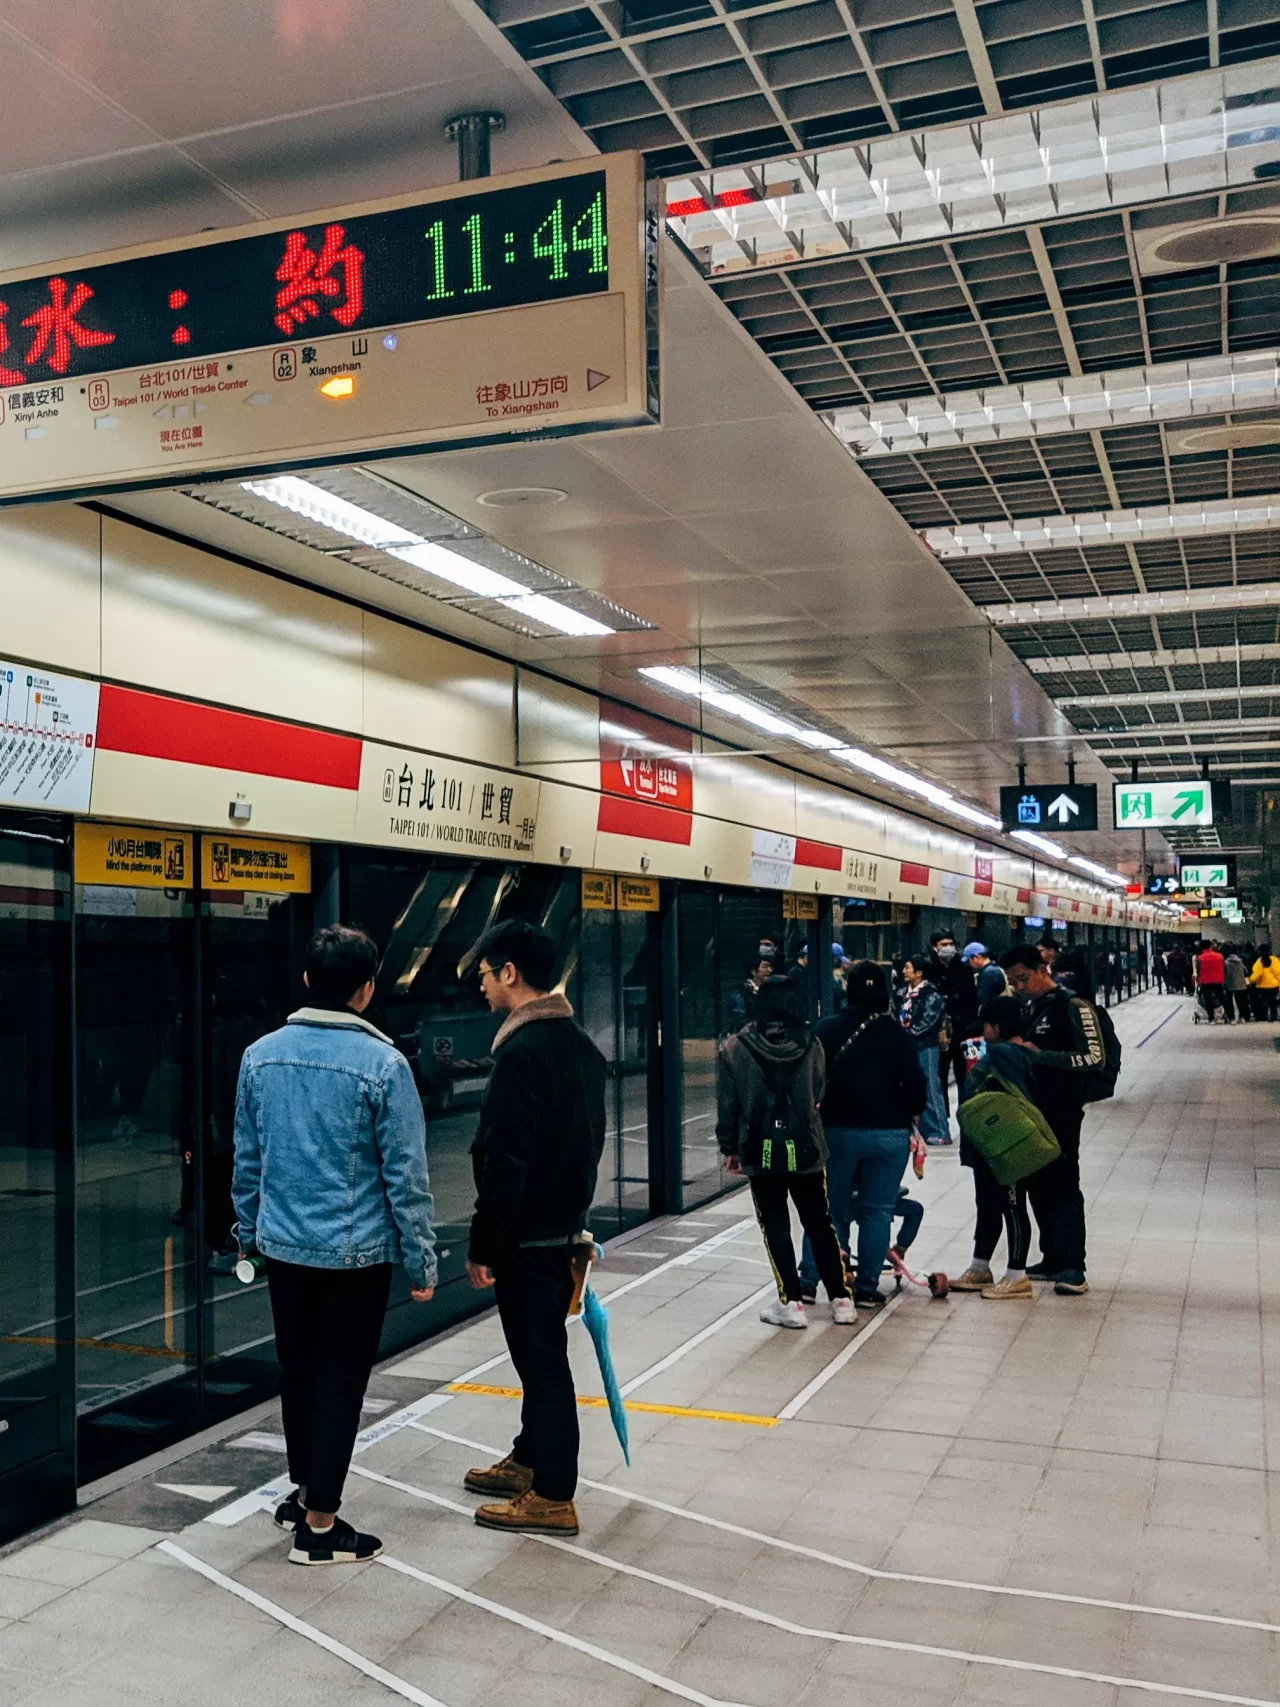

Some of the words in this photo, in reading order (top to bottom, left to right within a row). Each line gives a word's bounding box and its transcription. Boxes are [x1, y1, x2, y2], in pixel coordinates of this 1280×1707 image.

[424, 191, 608, 300] 11:44
[275, 224, 365, 334] 約
[280, 353, 289, 364] R
[139, 361, 219, 389] 台北101/世貿
[277, 365, 293, 377] 02
[308, 362, 361, 377] Xiangshan
[7, 386, 65, 410] 信義安和
[94, 384, 103, 395] R
[112, 395, 138, 408] Taipei
[140, 392, 154, 403] 101
[163, 386, 189, 400] World
[191, 383, 216, 396] Trade
[217, 379, 249, 393] Center
[476, 375, 568, 404] 往象山方向
[92, 395, 106, 407] 03
[486, 407, 499, 418] To
[501, 400, 559, 417] Xiangshan
[14, 411, 35, 423] Xinyi
[36, 407, 59, 419] Anhe
[159, 426, 203, 443] 現在位置
[186, 440, 203, 450] Here
[390, 817, 415, 836] TAIPEI
[416, 822, 431, 838] 101
[436, 824, 464, 843] WORLD
[465, 828, 487, 846] TRADE
[487, 832, 512, 850] CENTER
